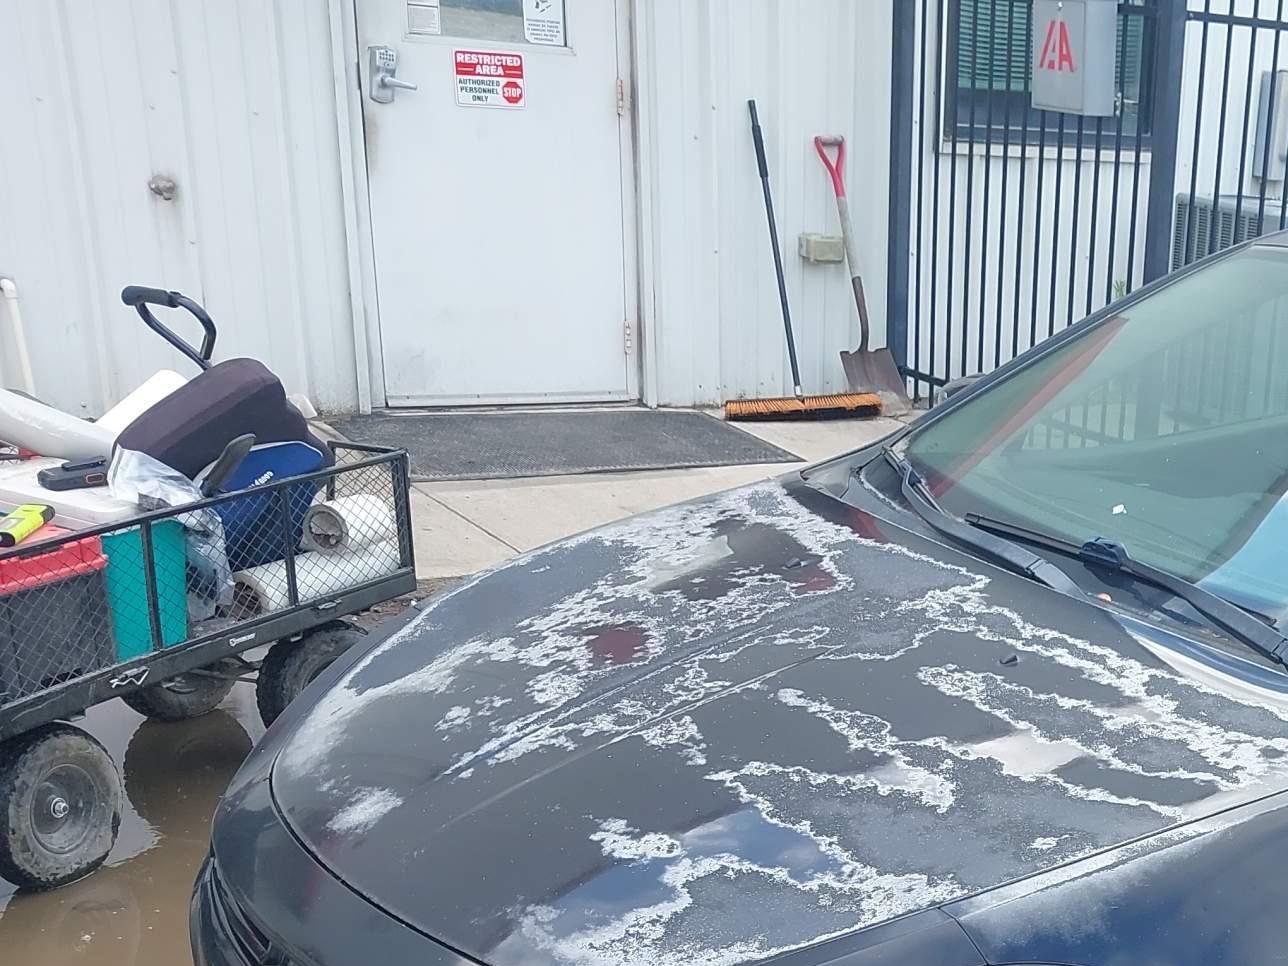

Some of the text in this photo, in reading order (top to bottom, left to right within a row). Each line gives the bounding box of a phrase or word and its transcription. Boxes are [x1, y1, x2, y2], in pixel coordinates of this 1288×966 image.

[456, 53, 521, 67] RESTRICTED
[475, 65, 504, 75] AREA
[458, 78, 500, 87] AUTHORIZED
[460, 86, 499, 95] PERSONNEL
[504, 87, 521, 98] STOP
